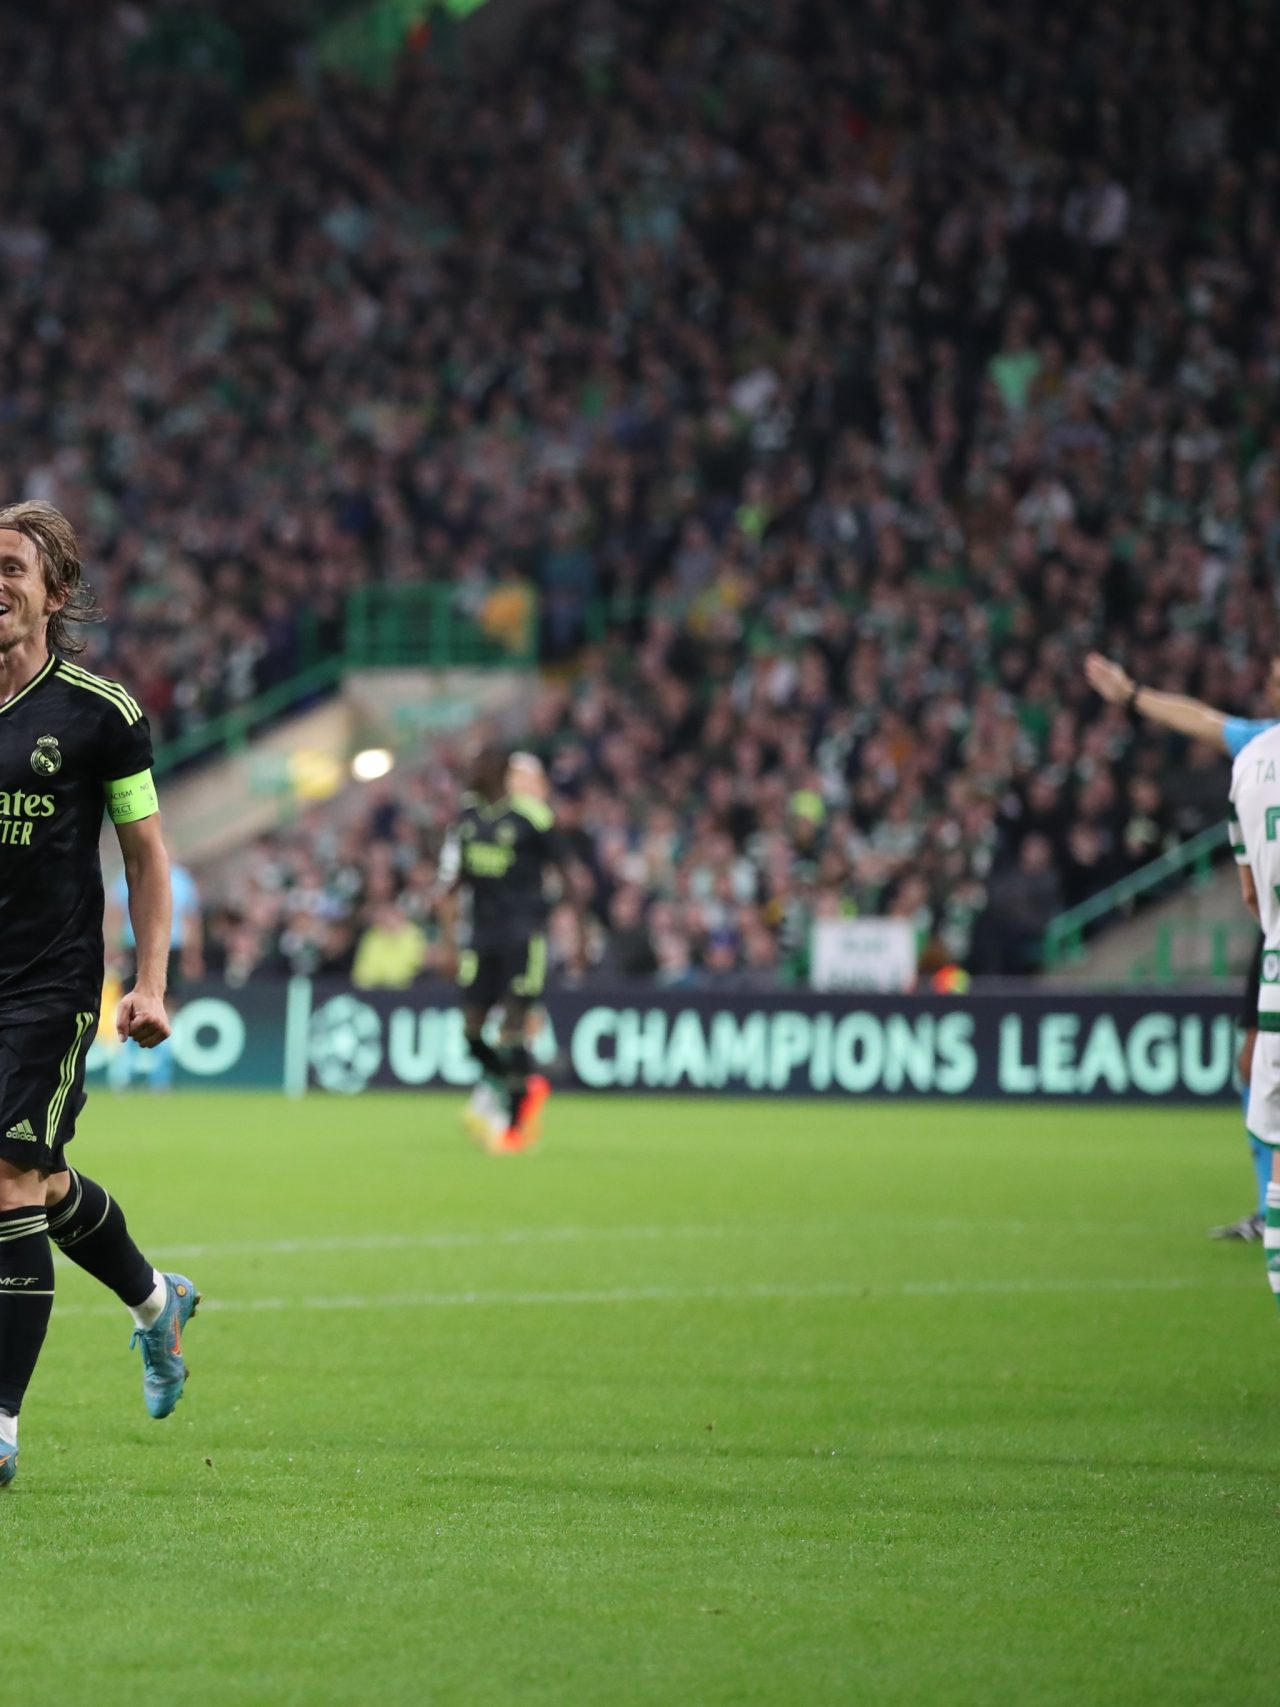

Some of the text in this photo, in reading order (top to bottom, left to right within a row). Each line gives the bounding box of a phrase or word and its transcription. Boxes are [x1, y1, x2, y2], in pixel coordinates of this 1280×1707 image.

[571, 1006, 978, 1094] CHAMPIONS
[998, 1012, 1246, 1096] LEAGU
[5, 1131, 38, 1142] adidas
